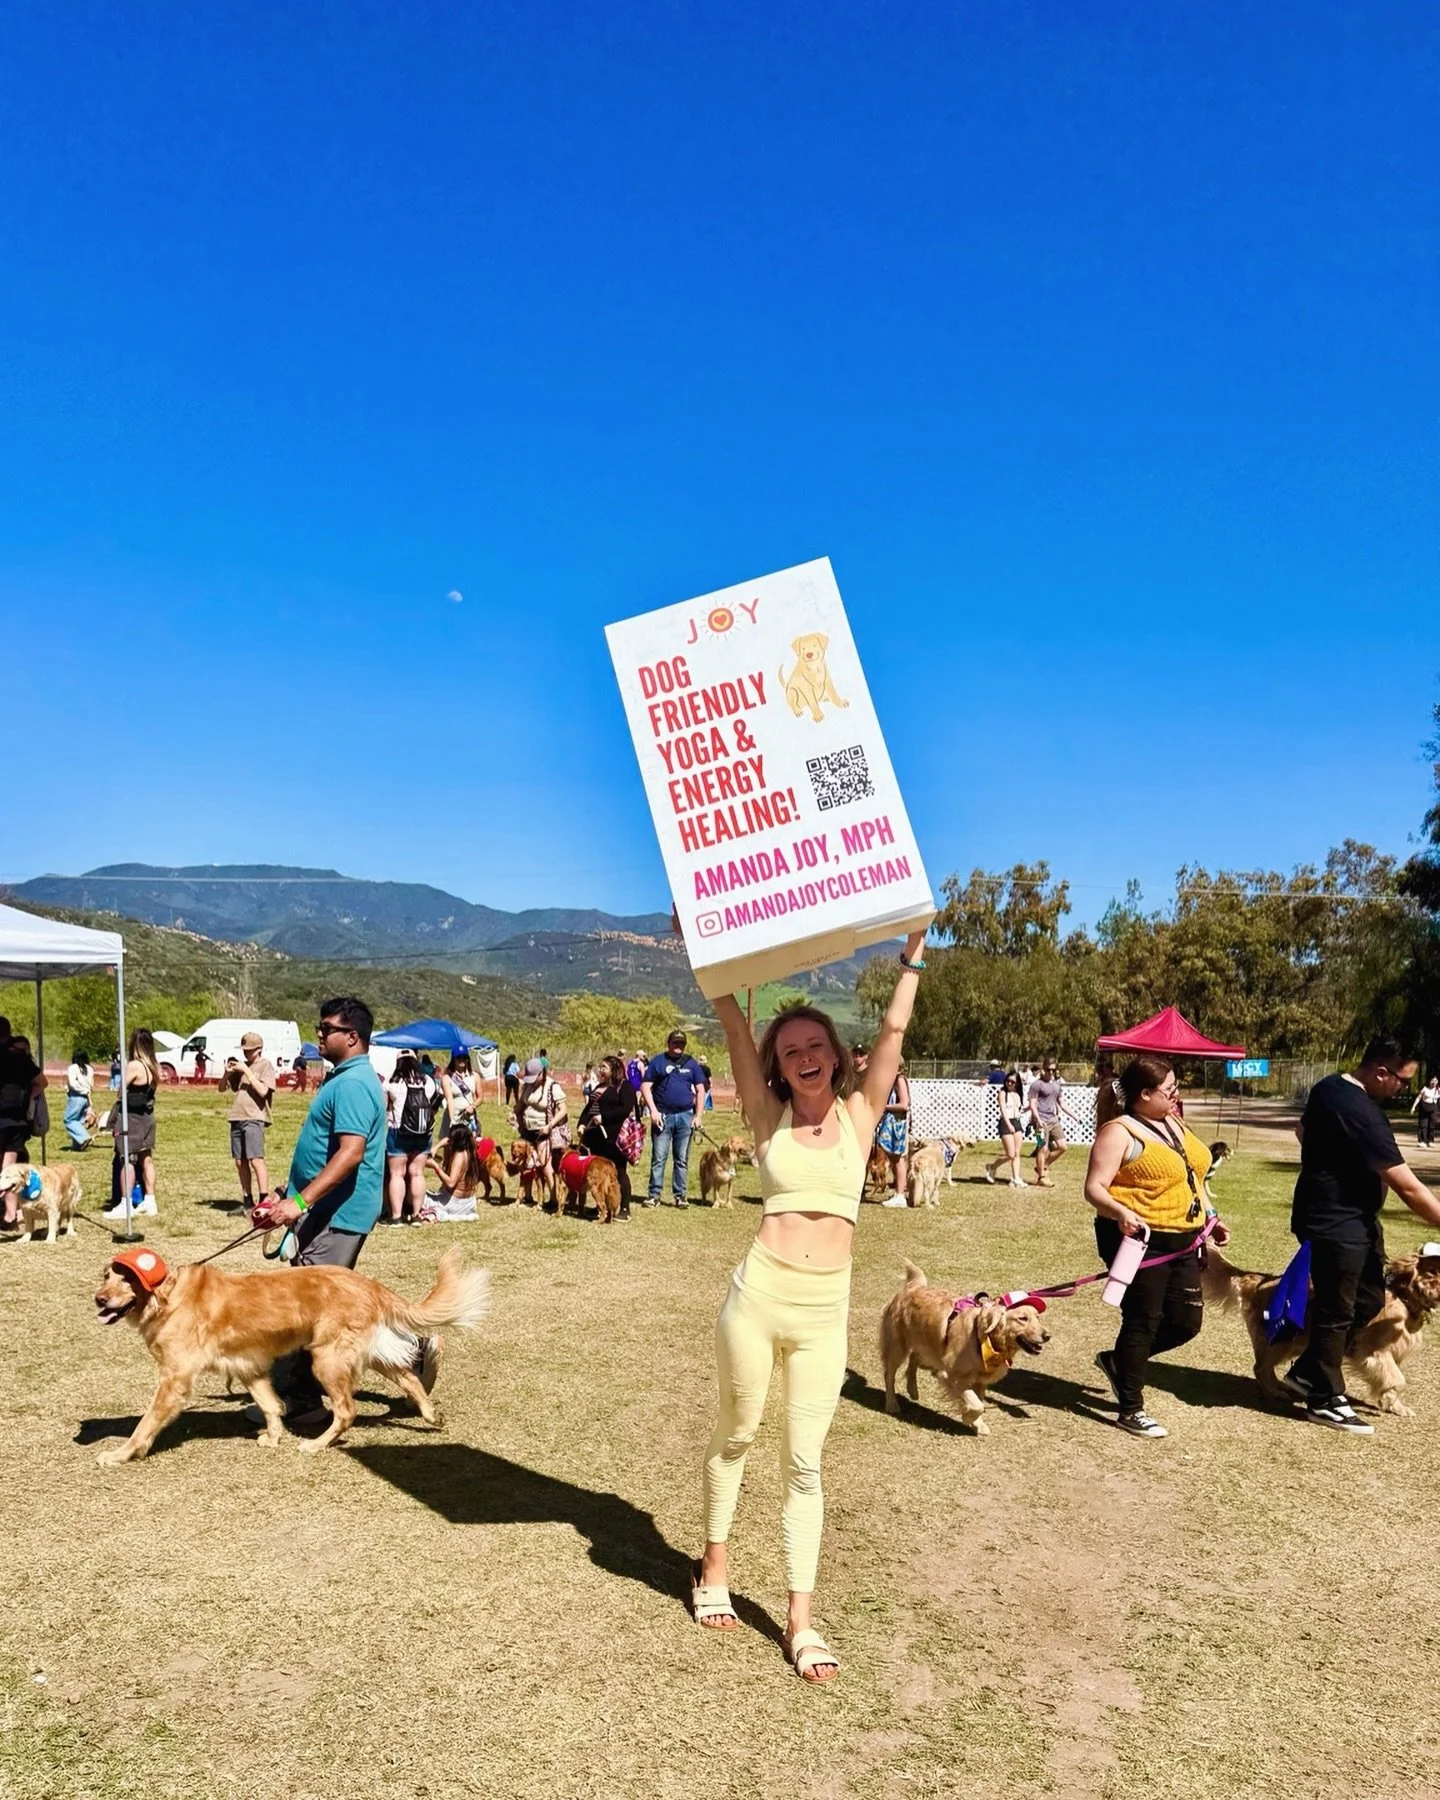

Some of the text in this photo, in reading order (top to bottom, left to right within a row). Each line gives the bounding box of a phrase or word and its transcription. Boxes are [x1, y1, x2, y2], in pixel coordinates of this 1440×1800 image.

[687, 598, 761, 645] JOY
[638, 655, 692, 699] DOG
[648, 671, 768, 737] FRIENDLY
[657, 719, 757, 775] YOGA &
[667, 755, 767, 815] ENERGY
[677, 787, 801, 853] HEALING!
[693, 815, 896, 900] AMANDA JOY, MPH
[724, 855, 912, 931] AMANDAJOYCOLEMAN
